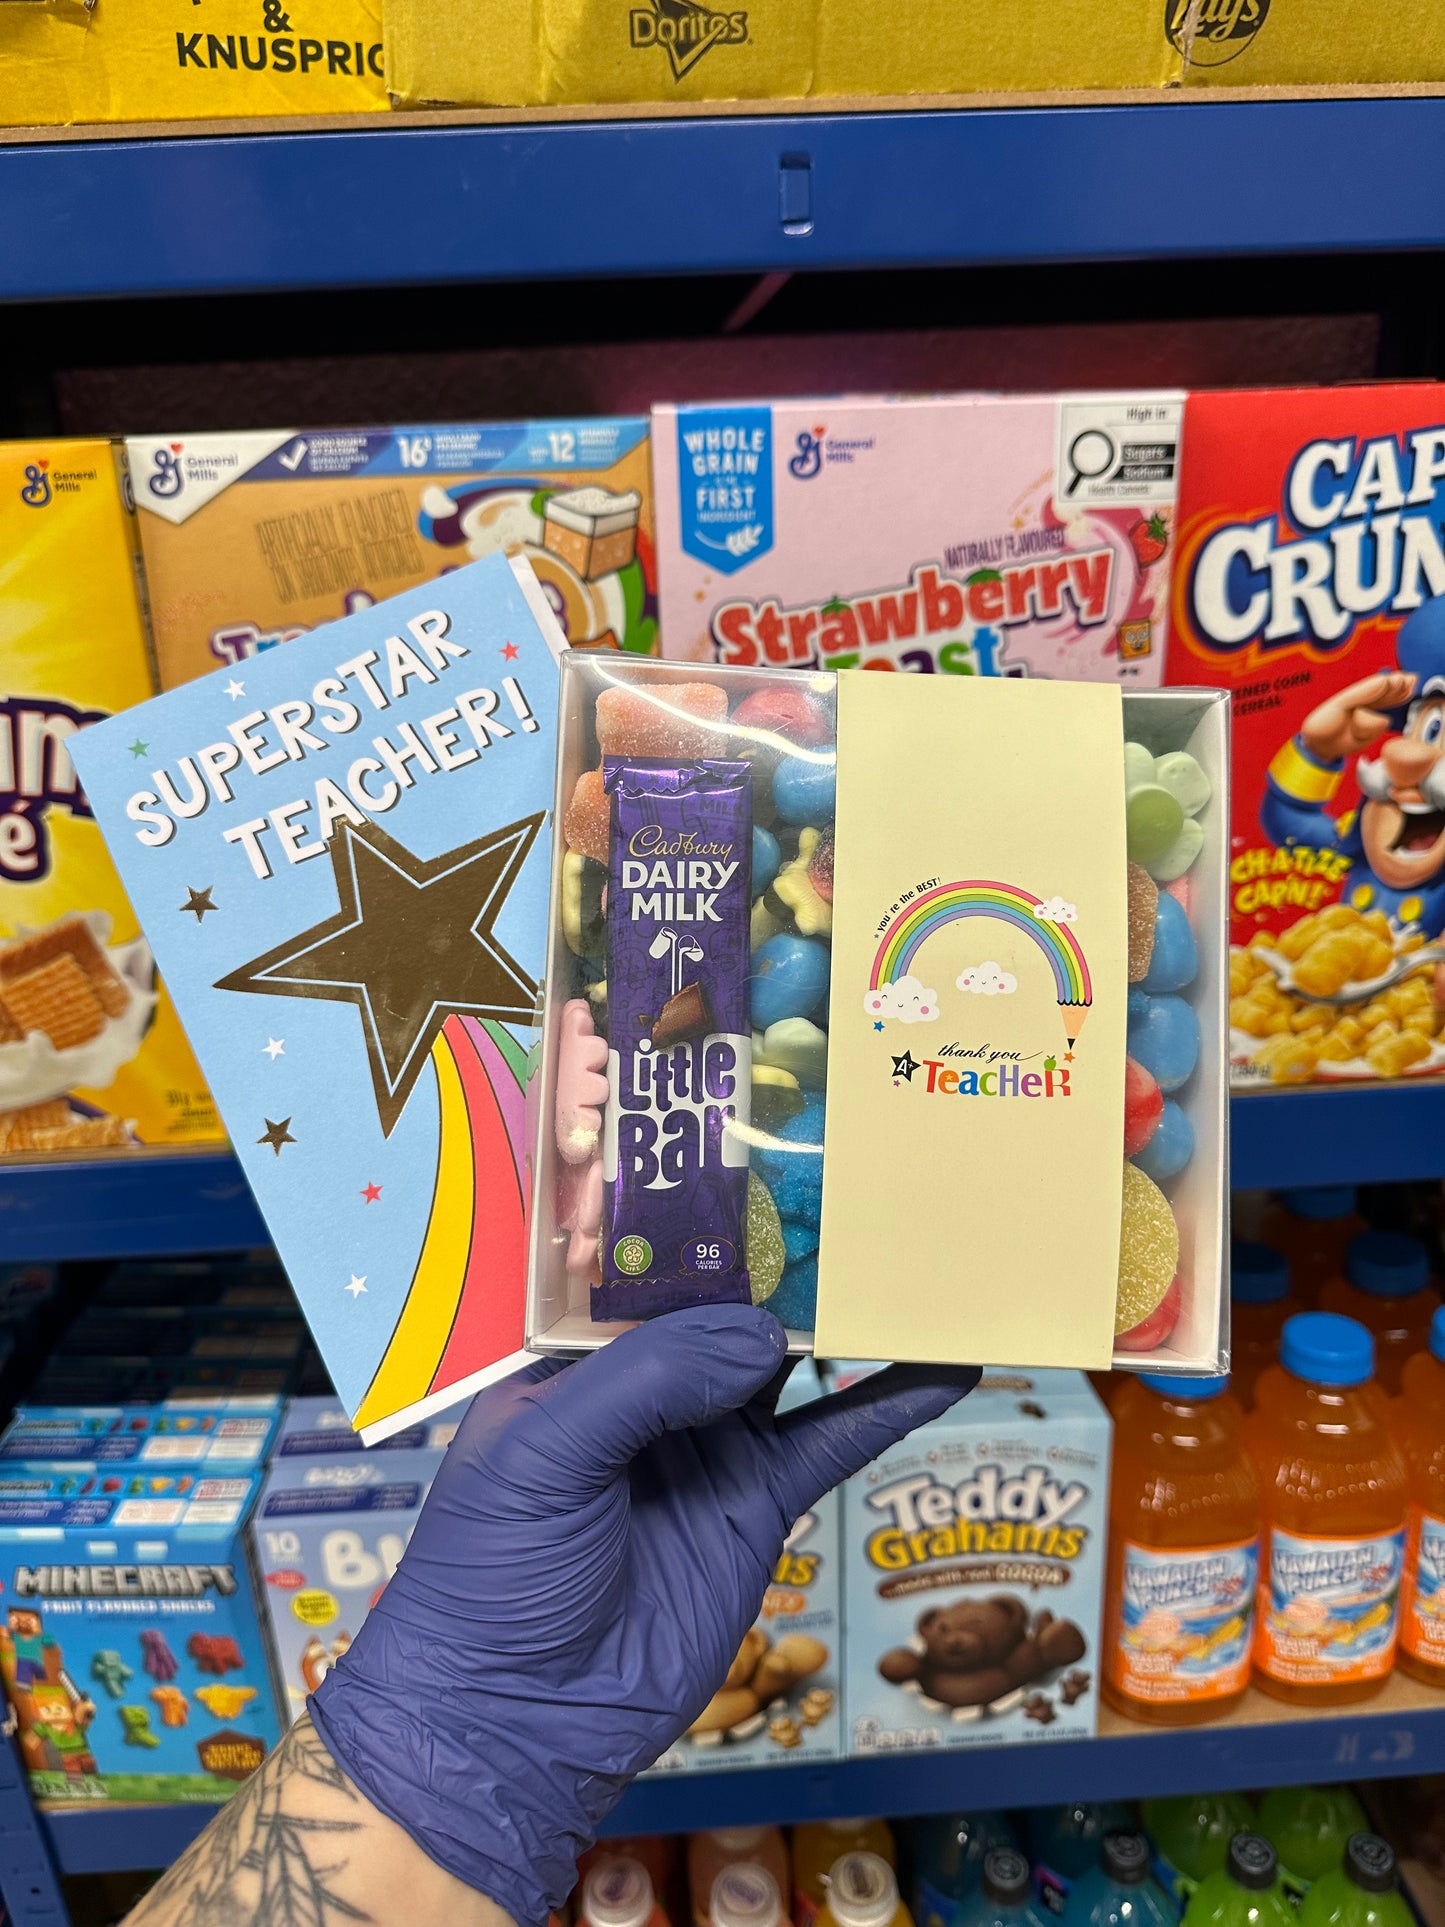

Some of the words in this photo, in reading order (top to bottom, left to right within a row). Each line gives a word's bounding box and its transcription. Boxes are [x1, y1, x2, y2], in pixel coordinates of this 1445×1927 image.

[263, 0, 294, 33] &
[630, 9, 748, 48] Doritos
[1127, 408, 1152, 423] High
[547, 431, 576, 463] 12
[684, 427, 766, 454] WHOLE
[826, 439, 875, 450] General
[187, 455, 238, 467] General
[692, 452, 759, 476] GRAIN
[826, 453, 854, 463] Mills
[53, 471, 97, 482] General
[54, 482, 81, 492] Mills
[187, 470, 218, 481] Mills
[696, 485, 756, 509] FIRST
[944, 535, 1003, 569] NATURALLY
[1004, 527, 1065, 561] FLAVOURED
[717, 550, 1113, 665] Strawberry
[126, 610, 471, 847] SUPERSTAR
[222, 677, 539, 879] TEACHER!
[629, 825, 733, 864] Cadbury
[622, 861, 740, 890] DAIRY
[899, 890, 915, 904] the
[916, 877, 942, 893] BEST!
[631, 893, 723, 922] MILK
[897, 1058, 914, 1074] A+
[938, 1042, 990, 1058] thank
[986, 1050, 1043, 1064] you
[619, 1039, 737, 1112] Little
[618, 1105, 736, 1190] Bar
[623, 1239, 645, 1247] COCOA
[696, 1244, 720, 1259] 96
[869, 1466, 1085, 1532] Teddy
[263, 1532, 300, 1553] 10
[869, 1517, 1088, 1570] Grahams
[15, 1565, 238, 1597] MINECRAFT
